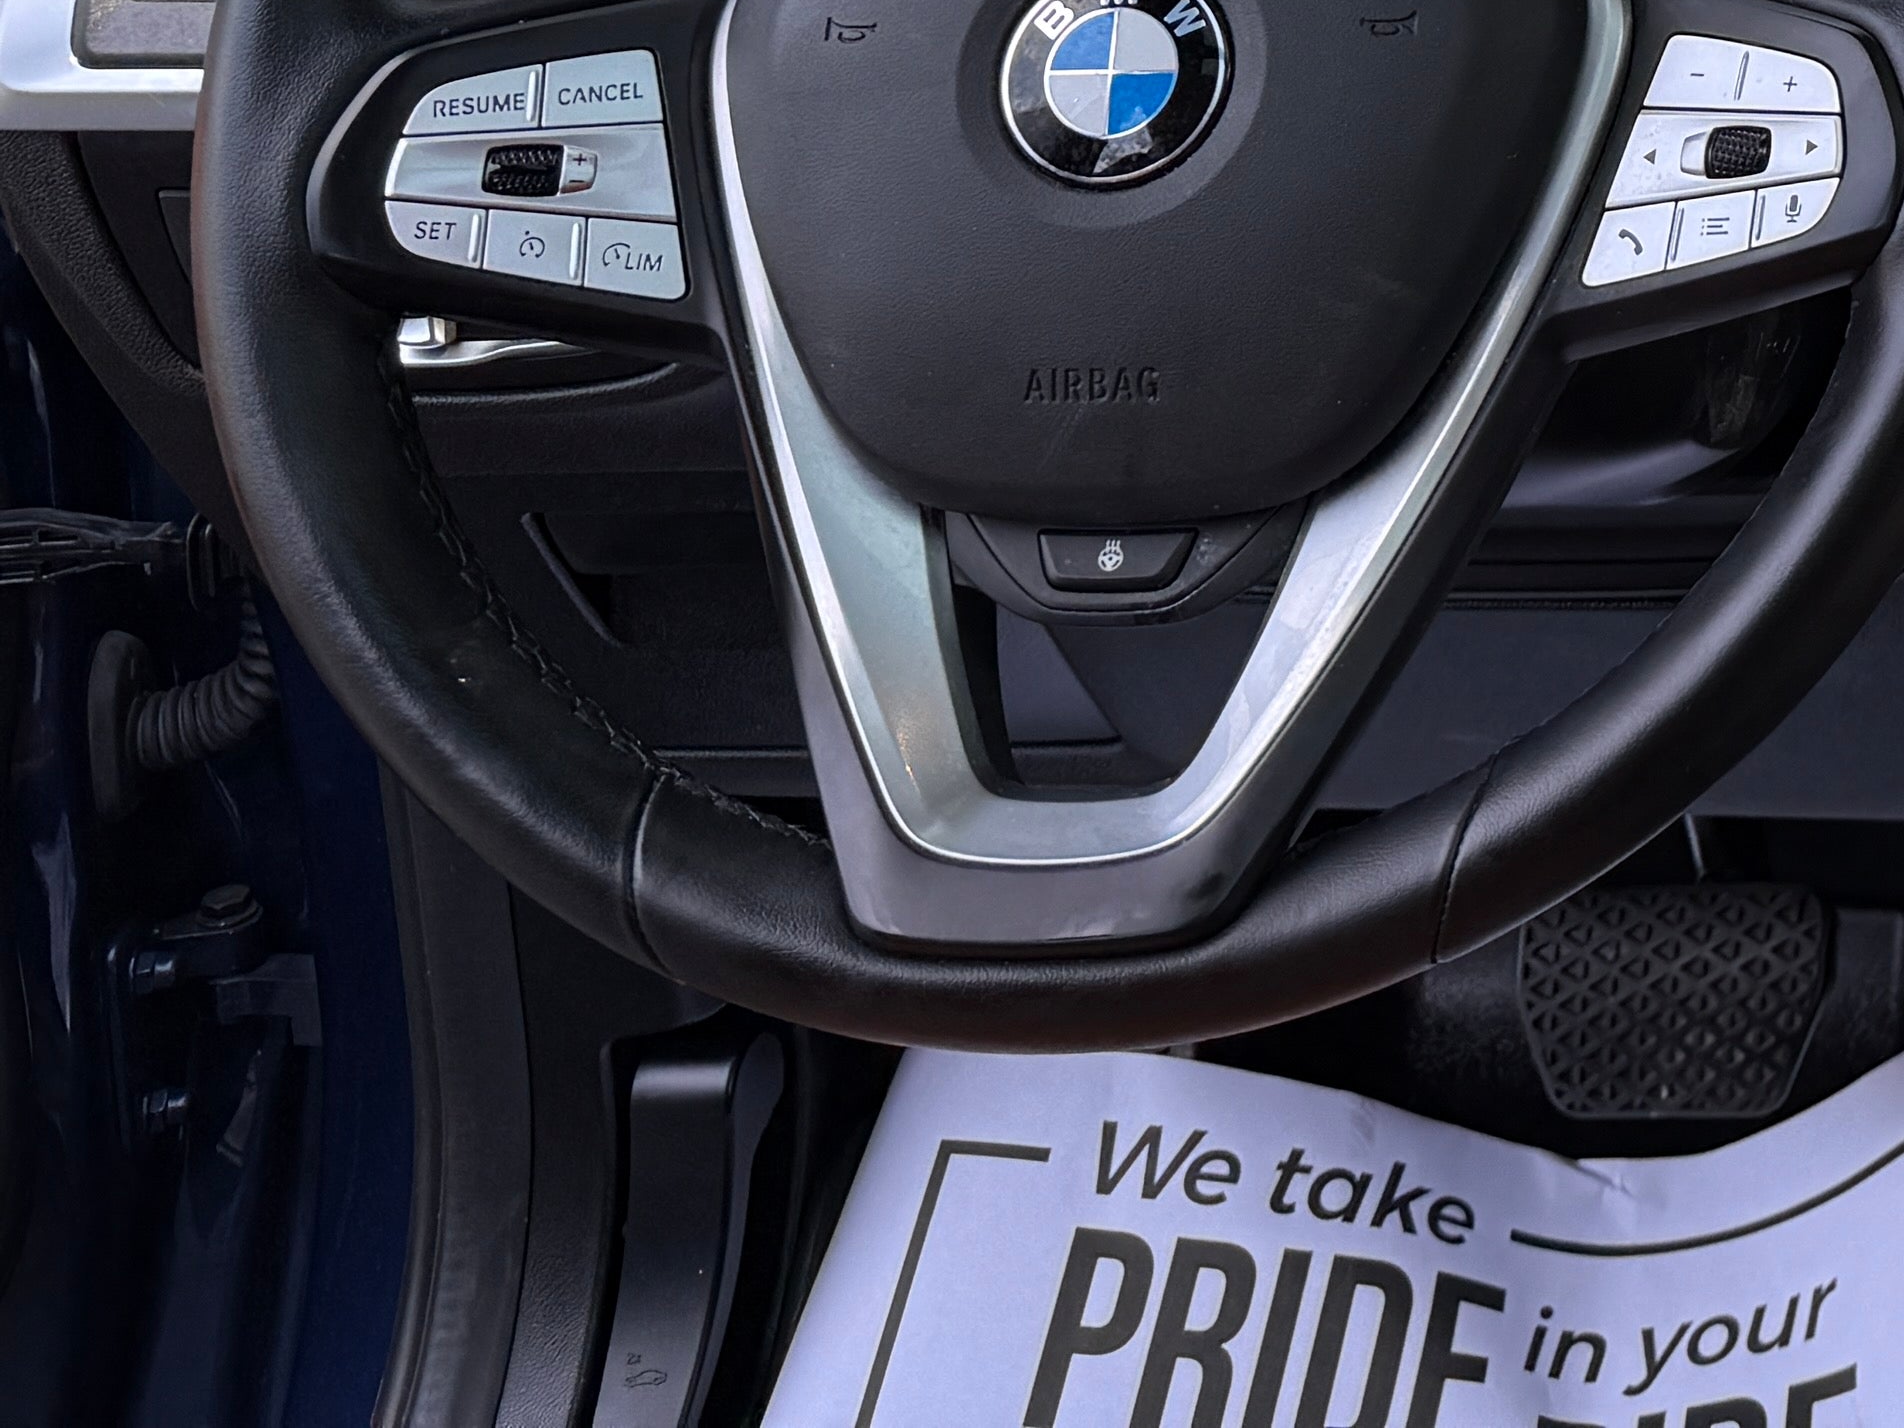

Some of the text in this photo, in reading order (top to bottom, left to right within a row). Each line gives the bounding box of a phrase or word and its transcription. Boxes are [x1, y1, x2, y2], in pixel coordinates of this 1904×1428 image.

[433, 91, 526, 119] RESUME
[557, 81, 644, 106] CANCEL
[413, 221, 457, 242] SET
[624, 251, 664, 273] LIM
[1023, 366, 1162, 405] AIRBAG
[1095, 1118, 1476, 1246] We take
[1022, 1225, 1507, 1428] PRIDE
[1522, 1305, 1608, 1385] in
[1621, 1276, 1839, 1399] your
